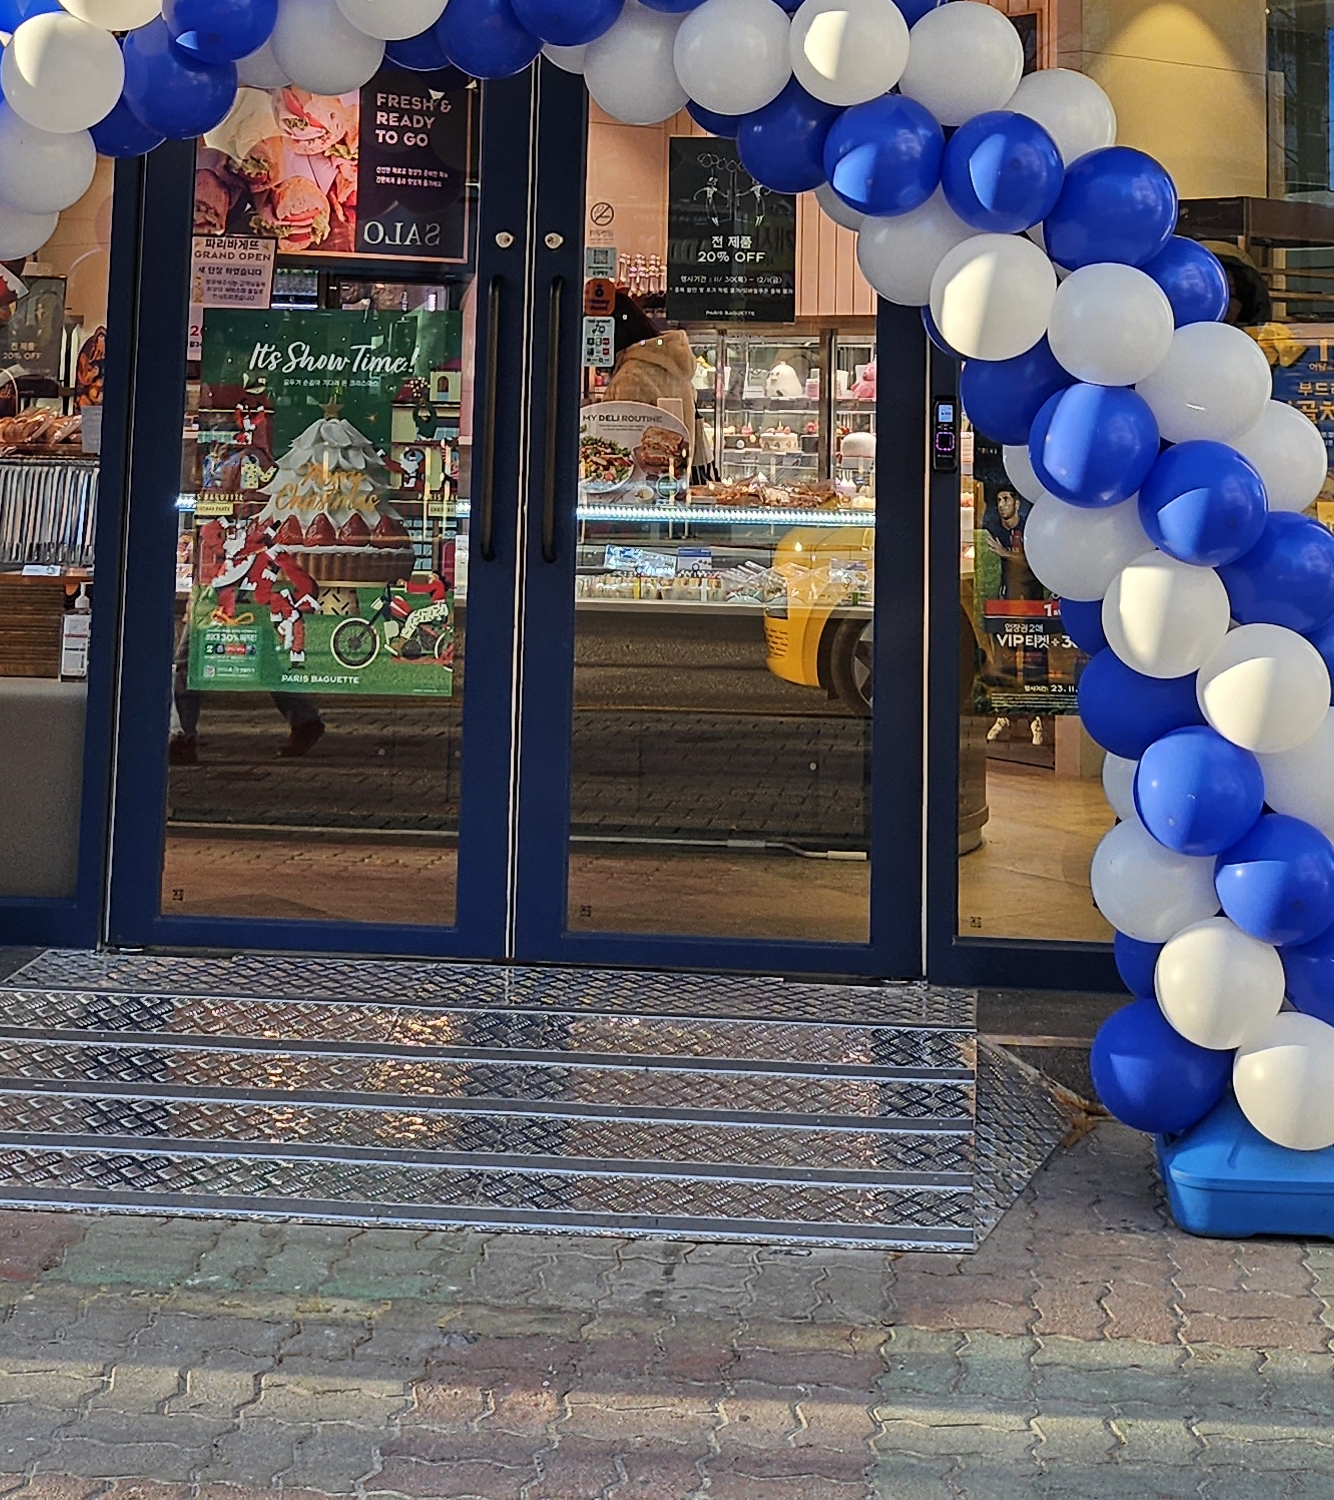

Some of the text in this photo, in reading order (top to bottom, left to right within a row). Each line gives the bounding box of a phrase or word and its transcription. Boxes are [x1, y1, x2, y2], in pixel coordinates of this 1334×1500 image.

[376, 92, 452, 113] FRESH &
[375, 111, 435, 129] READY
[375, 130, 429, 147] TO GO
[205, 238, 260, 251] 파리바게뜨
[711, 235, 753, 250] 전 제품
[194, 250, 271, 262] GRAND OPEN
[697, 251, 766, 263] 20% OFF
[190, 325, 203, 337] 2
[249, 343, 282, 371] It's
[282, 341, 351, 374] Show
[583, 414, 663, 423] MY DELI ROUTINE
[281, 674, 360, 684] PARIS BAGUETTE
